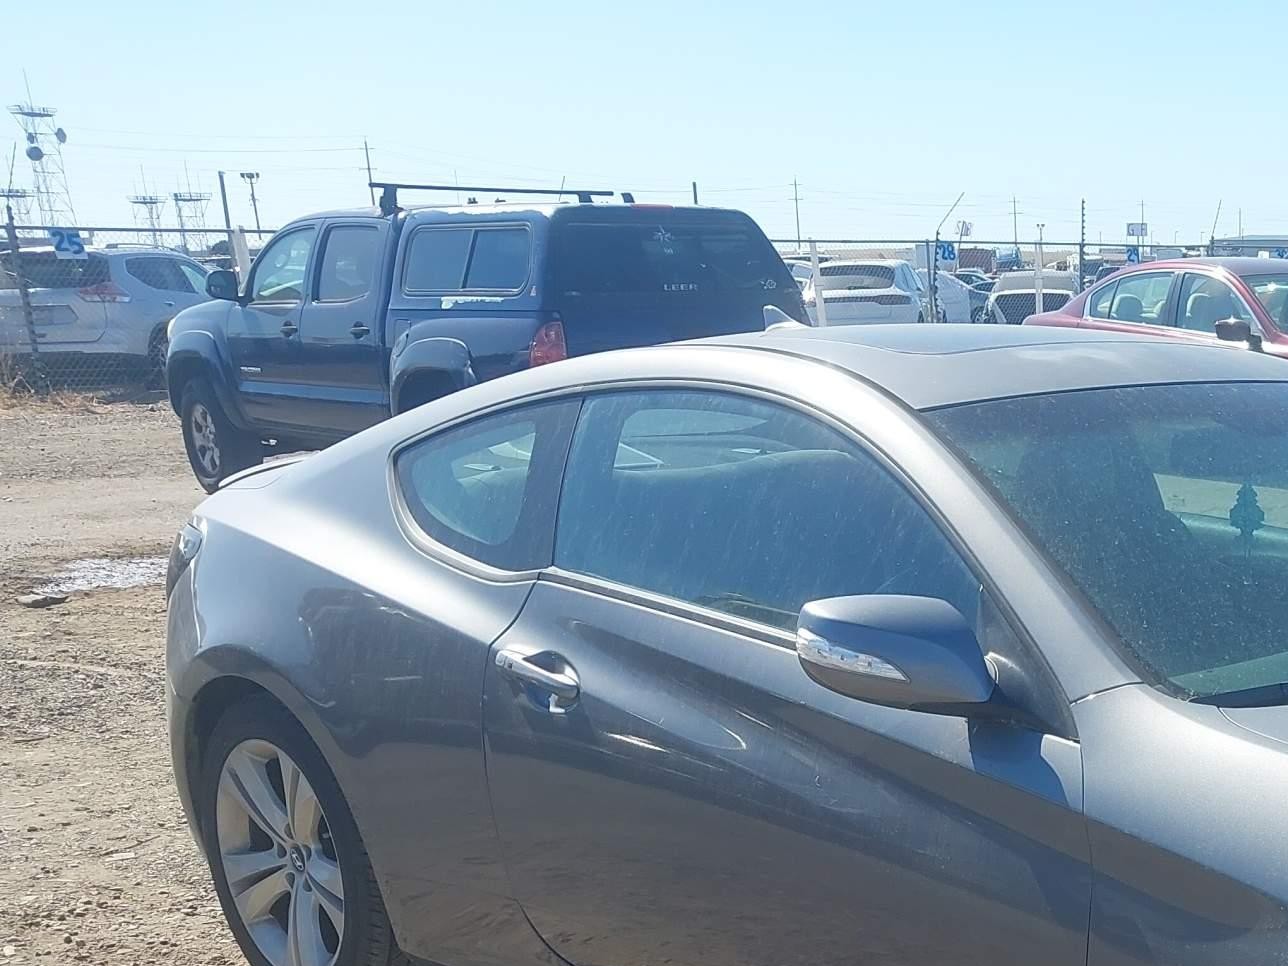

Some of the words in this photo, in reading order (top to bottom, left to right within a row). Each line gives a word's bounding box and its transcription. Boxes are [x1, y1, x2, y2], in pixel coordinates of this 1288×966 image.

[51, 230, 85, 255] 25
[937, 243, 956, 260] 28
[1126, 248, 1139, 264] 29
[663, 283, 698, 291] LEER
